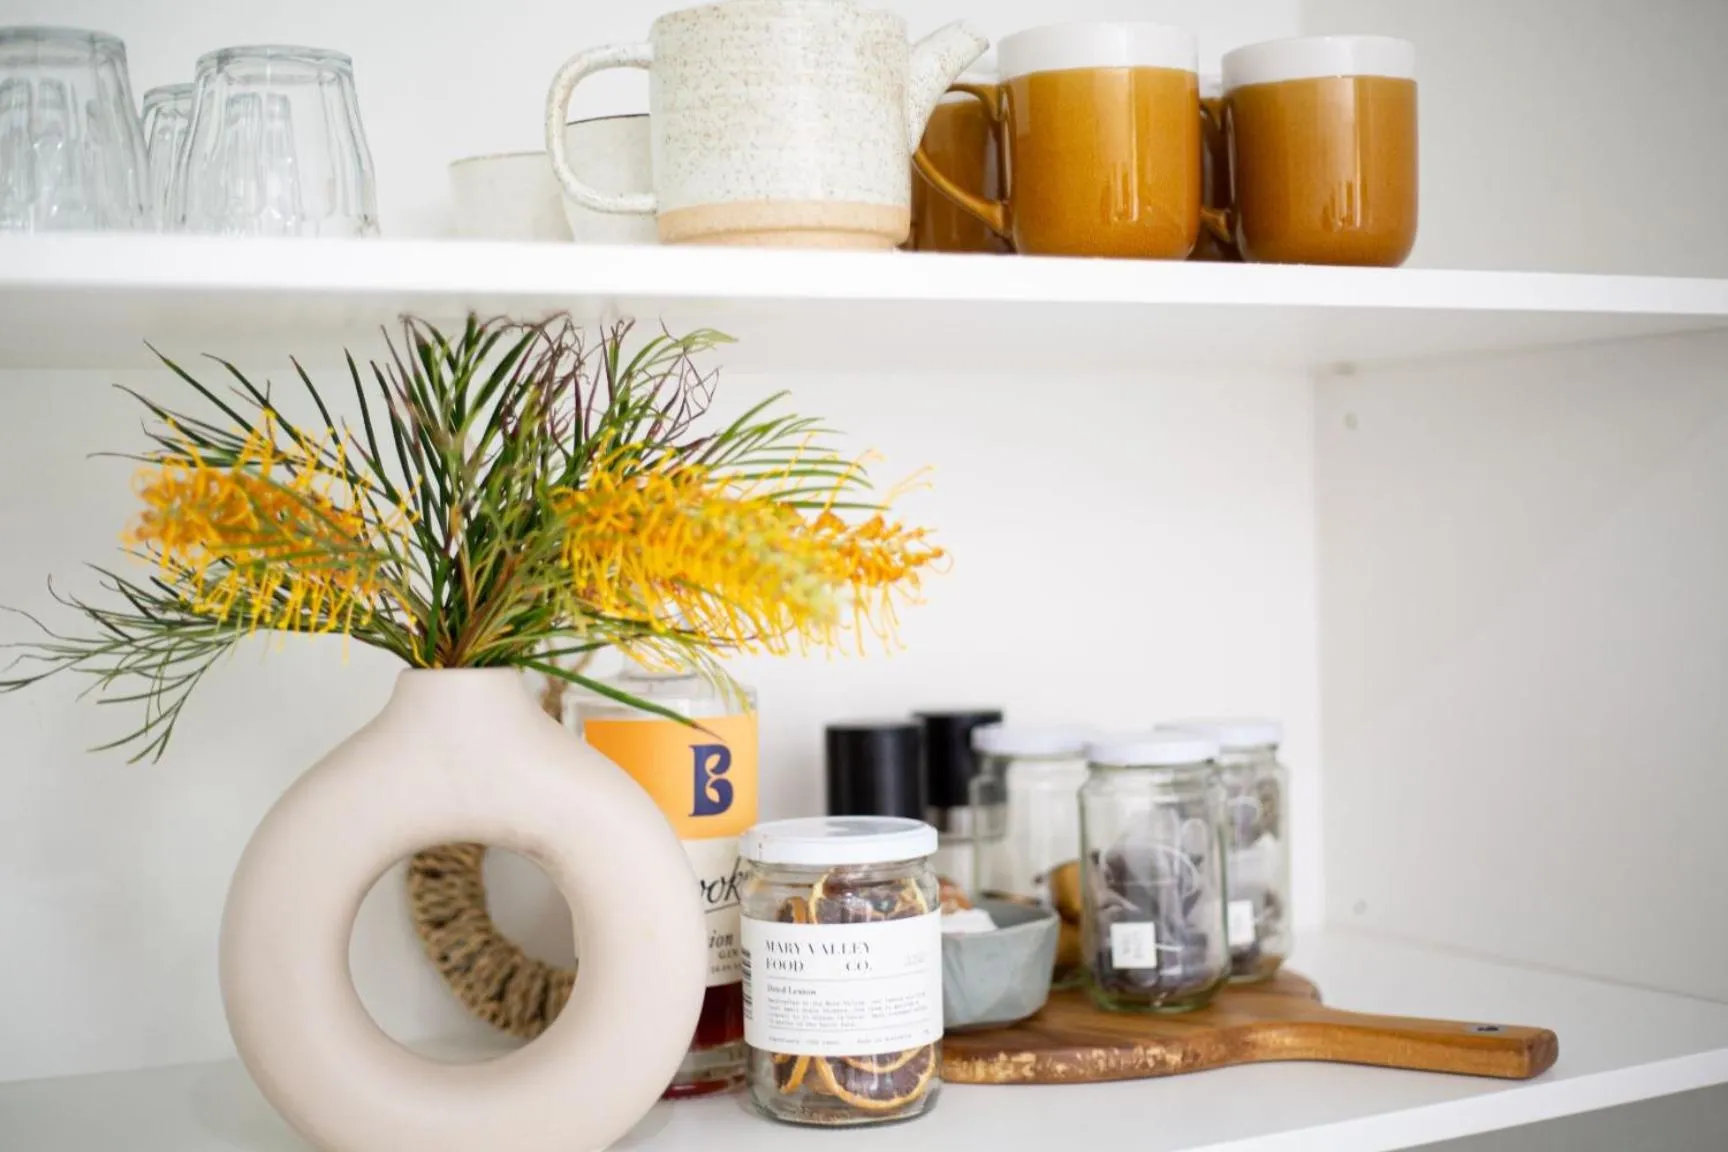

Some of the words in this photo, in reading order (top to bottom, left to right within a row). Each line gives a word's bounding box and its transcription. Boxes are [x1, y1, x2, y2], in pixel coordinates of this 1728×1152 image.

[688, 744, 733, 817] B
[766, 939, 800, 955] MARY
[808, 942, 869, 956] VALLEY
[766, 958, 804, 973] FOOD
